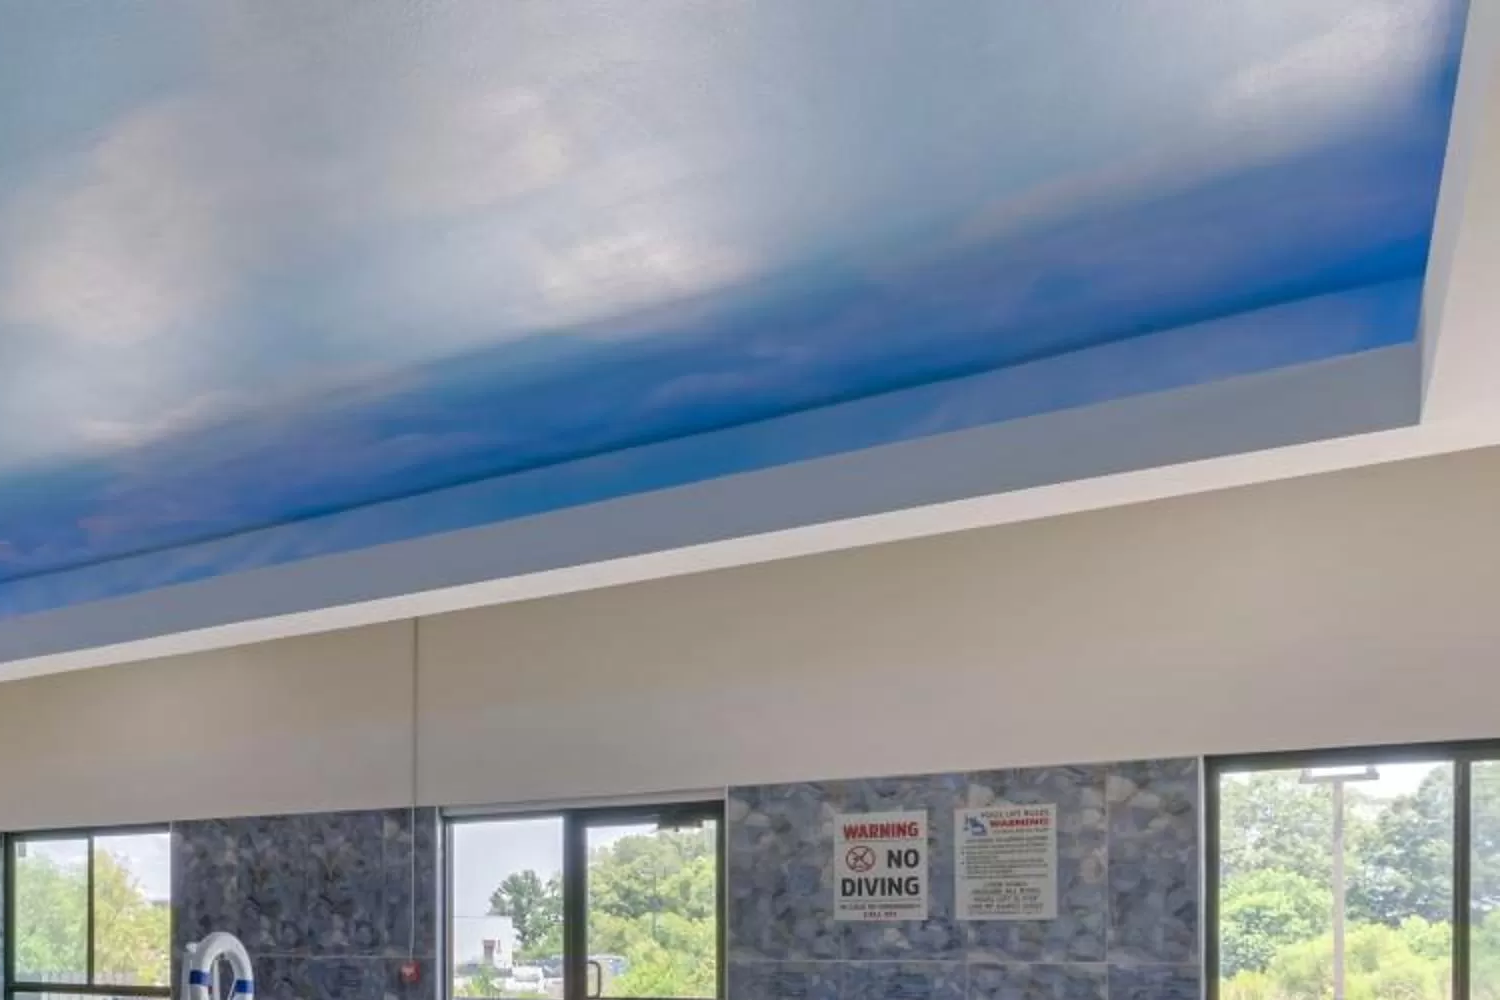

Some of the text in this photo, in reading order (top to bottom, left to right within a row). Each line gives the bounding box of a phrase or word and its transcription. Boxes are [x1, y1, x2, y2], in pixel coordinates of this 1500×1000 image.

[843, 822, 919, 839] WARNING
[887, 849, 920, 869] NO
[841, 876, 920, 897] DIVING
